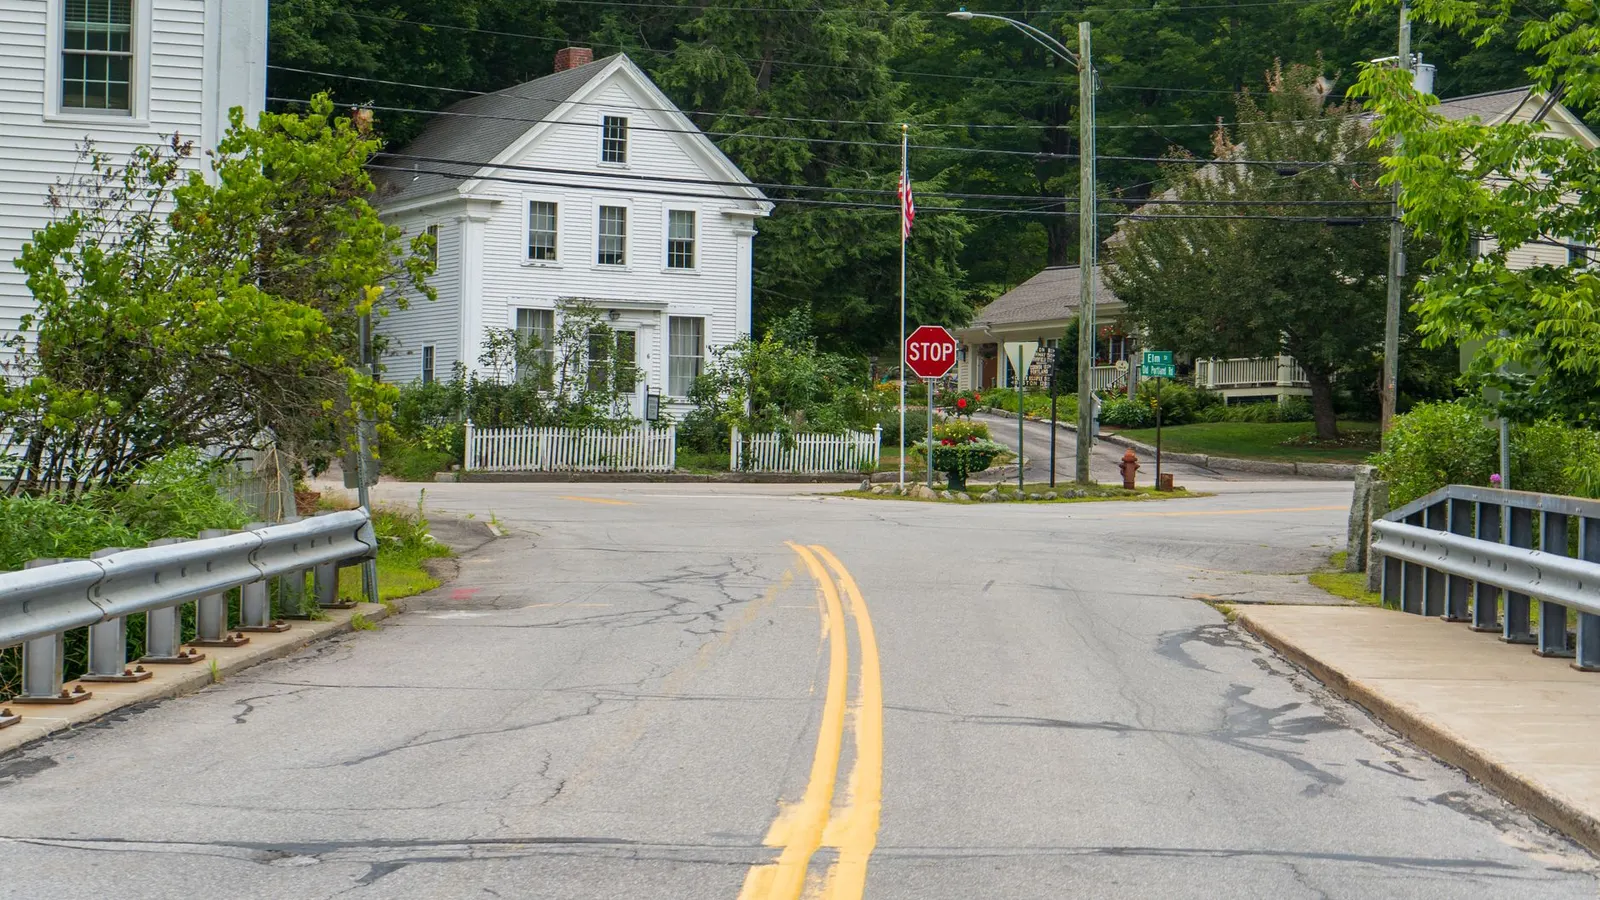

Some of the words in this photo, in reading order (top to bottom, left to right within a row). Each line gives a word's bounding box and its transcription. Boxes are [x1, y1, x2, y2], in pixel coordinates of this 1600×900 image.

[909, 342, 953, 361] STOP
[1148, 354, 1160, 362] Elm
[1151, 366, 1167, 375] Portland
[1168, 366, 1174, 376] Rd
